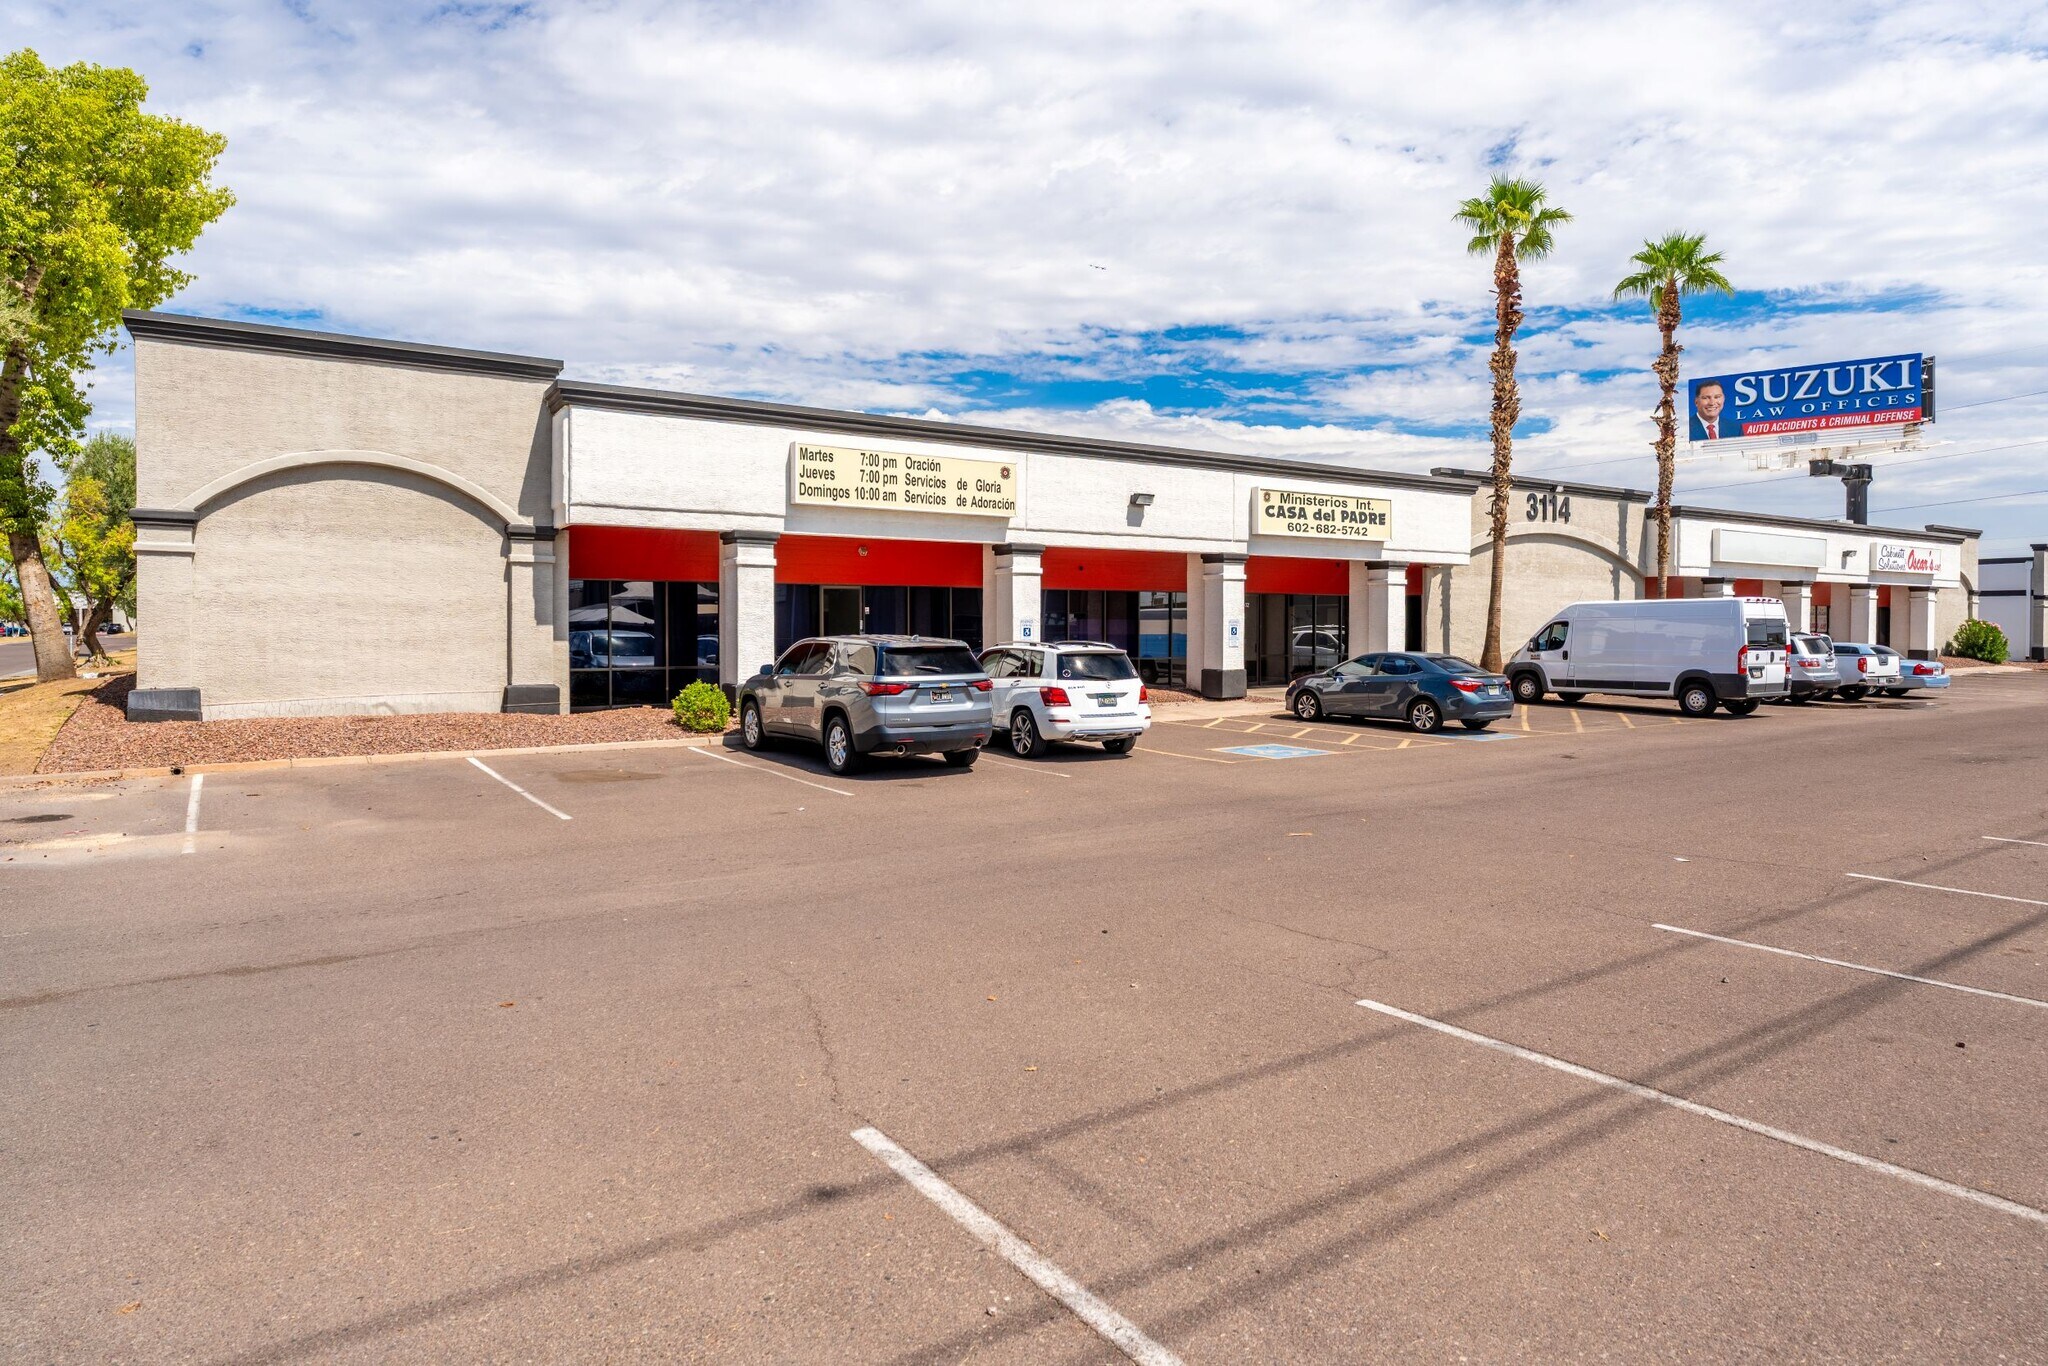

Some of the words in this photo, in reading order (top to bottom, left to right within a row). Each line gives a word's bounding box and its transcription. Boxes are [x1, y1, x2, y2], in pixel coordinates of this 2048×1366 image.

[1734, 358, 1915, 406] SUZUKI
[1736, 406, 1785, 420] LAW
[1801, 393, 1915, 413] OFFICES
[1747, 423, 1769, 434] AUTO
[1771, 420, 1817, 432] ACCIDENTS
[1820, 419, 1826, 427] &
[1829, 414, 1871, 426] CRIMINAL
[1874, 410, 1915, 423] DEFENSE
[799, 447, 834, 463] Martes
[860, 452, 880, 467] 7:00
[882, 456, 898, 471] pm
[905, 456, 941, 472] Oración
[799, 464, 836, 480] Jueves
[860, 469, 880, 484] 7:00
[882, 473, 898, 486] pm
[904, 473, 947, 489] Servicios
[956, 478, 968, 491] de
[975, 479, 1001, 493] Gloria
[799, 482, 850, 501] Domingos
[854, 487, 880, 501] 10:00
[882, 491, 897, 502] am
[904, 489, 947, 506] Servicios
[956, 494, 968, 507] de
[970, 495, 1015, 511] Adoración
[1280, 492, 1348, 509] Ministerios
[1356, 499, 1374, 511] Int.
[1526, 492, 1571, 524] 3114
[1264, 505, 1308, 520] CASA
[1312, 508, 1335, 522] del
[1341, 510, 1387, 526] PADRE
[1287, 522, 1368, 536] 602-682-5742
[1907, 549, 1934, 571] Oscar's
